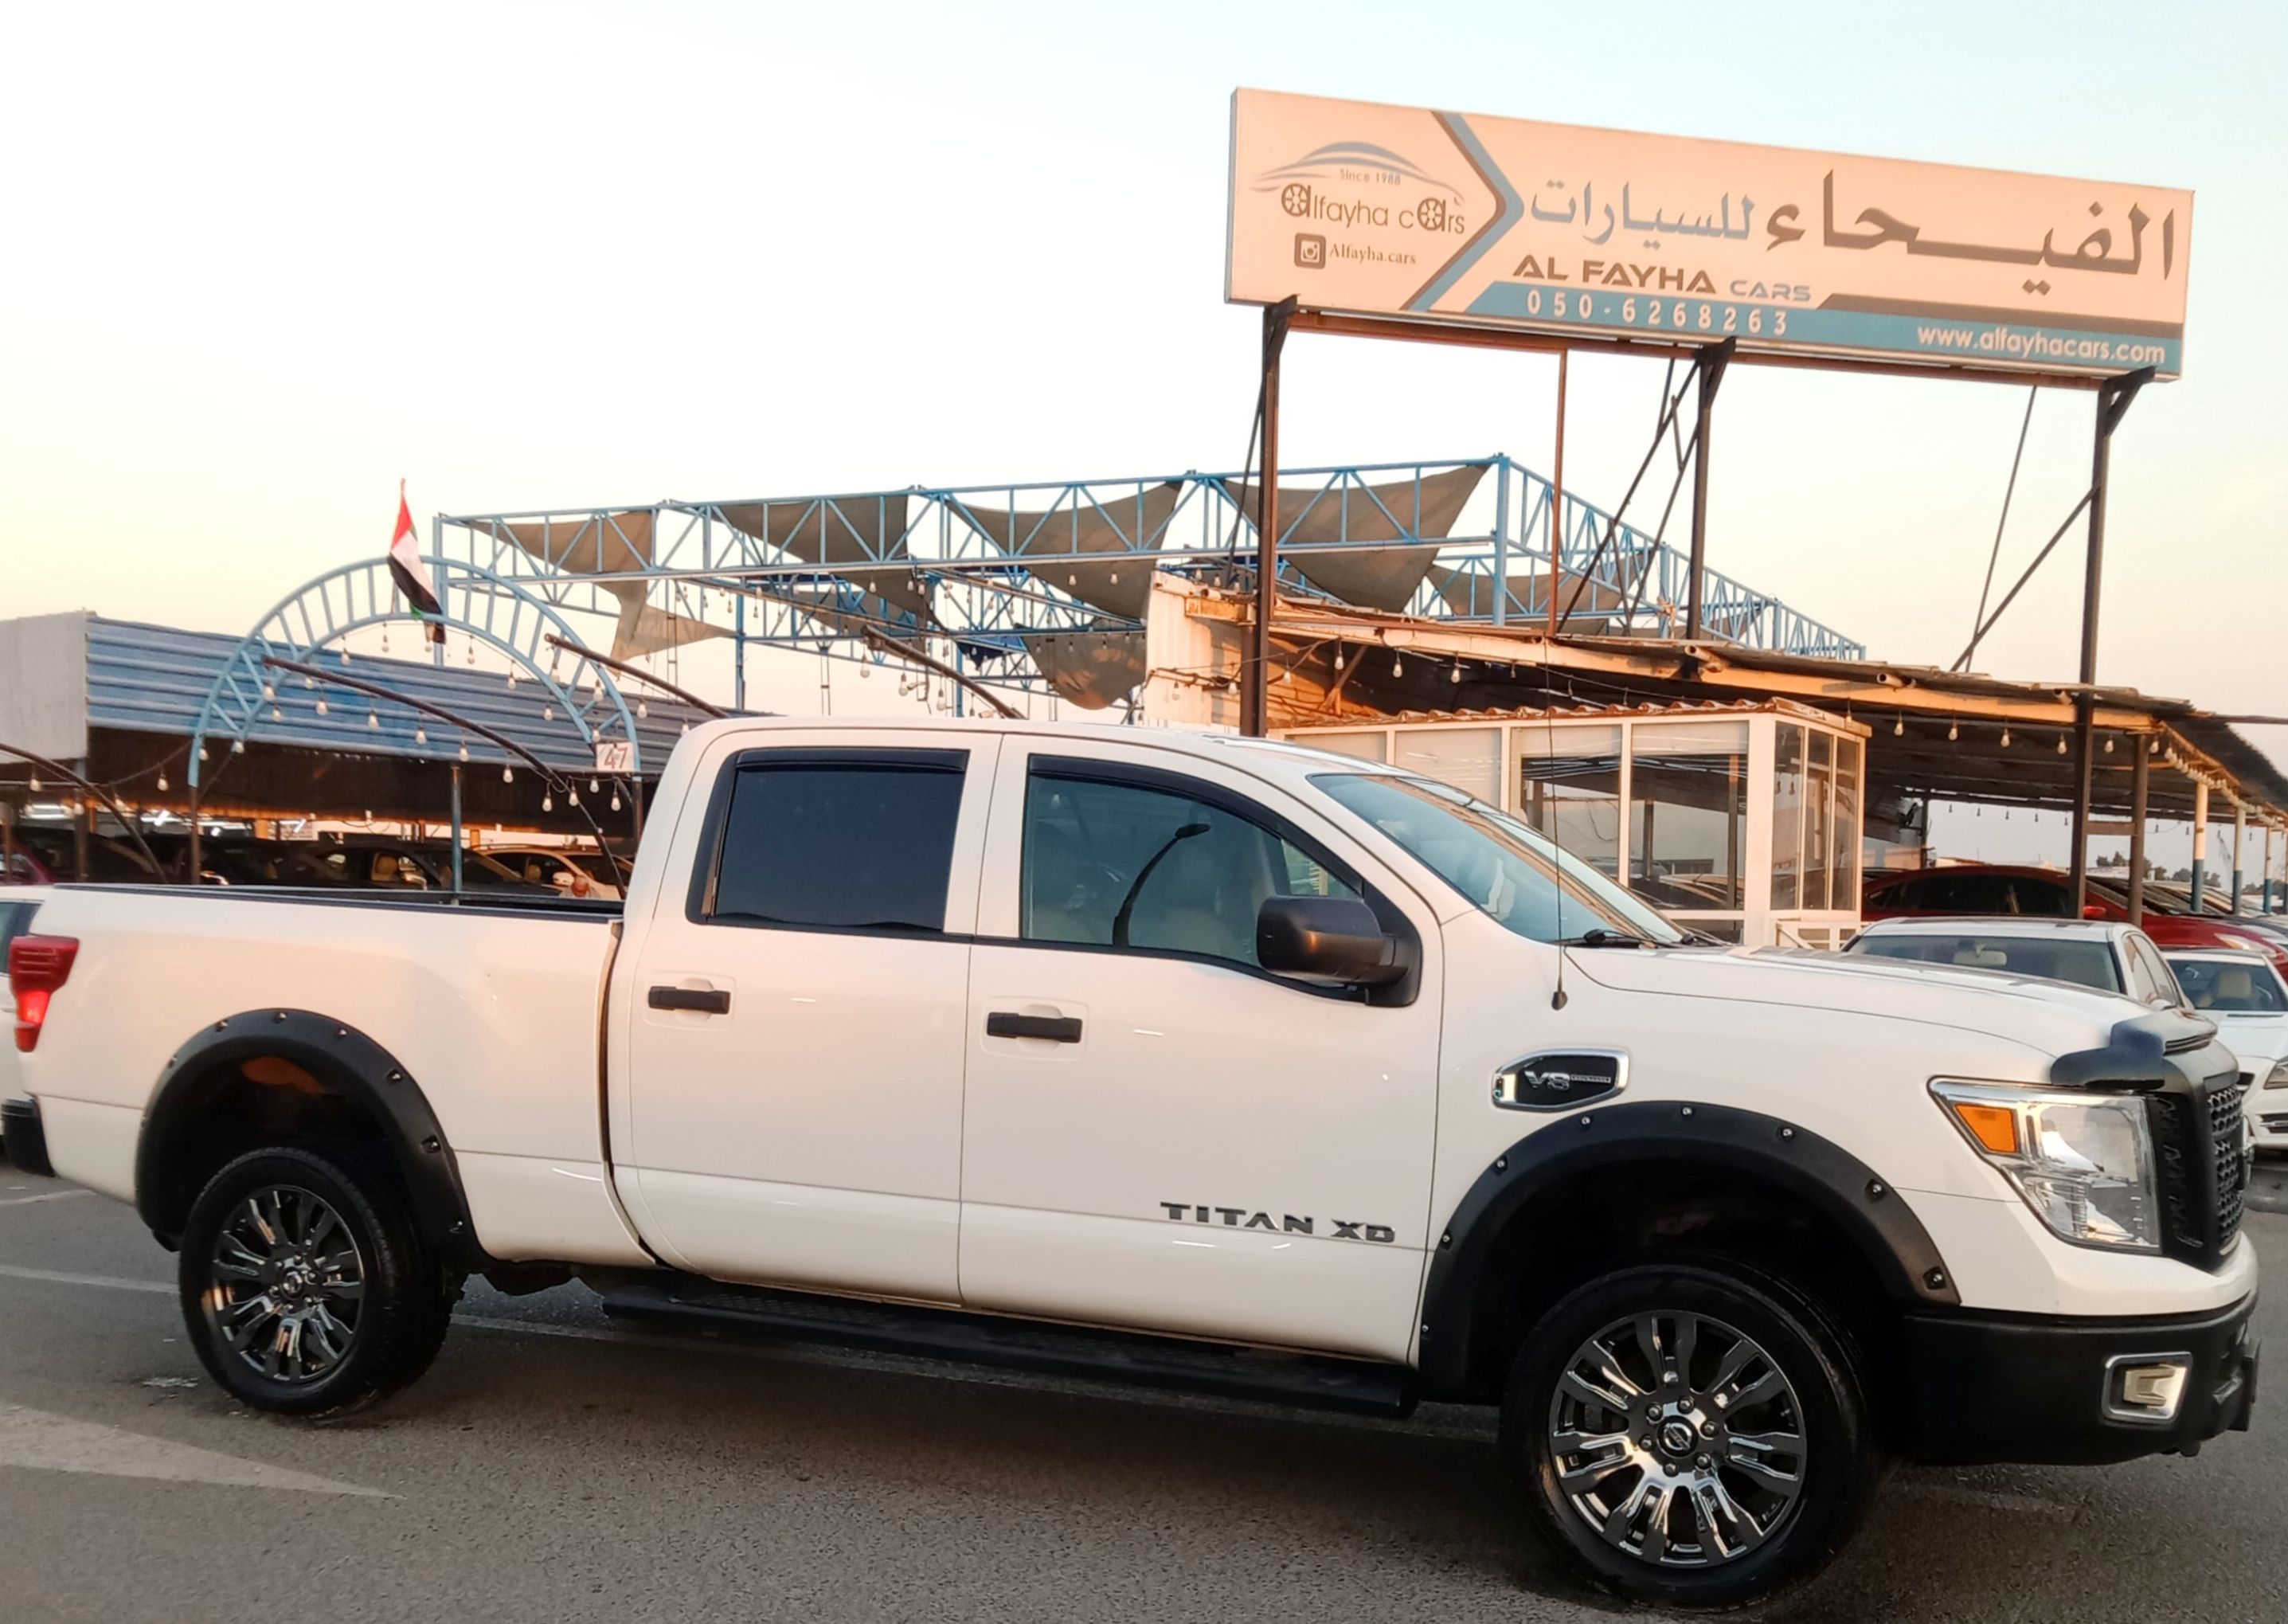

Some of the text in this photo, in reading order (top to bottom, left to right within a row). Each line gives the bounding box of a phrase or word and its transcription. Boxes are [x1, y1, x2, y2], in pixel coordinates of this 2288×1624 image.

[1340, 168, 1402, 186] Since 1988
[1398, 198, 1465, 234] cars
[1531, 167, 2175, 296] الفيحاء للسيارات
[1329, 243, 1416, 265] Alfayha.cars
[1512, 254, 1811, 302] AL FAYHA CARS
[1918, 326, 2165, 364] www.alfayhacars.com
[604, 746, 628, 769] 47
[1523, 1070, 1570, 1090] V8
[1160, 1201, 1395, 1243] TITAN XD
